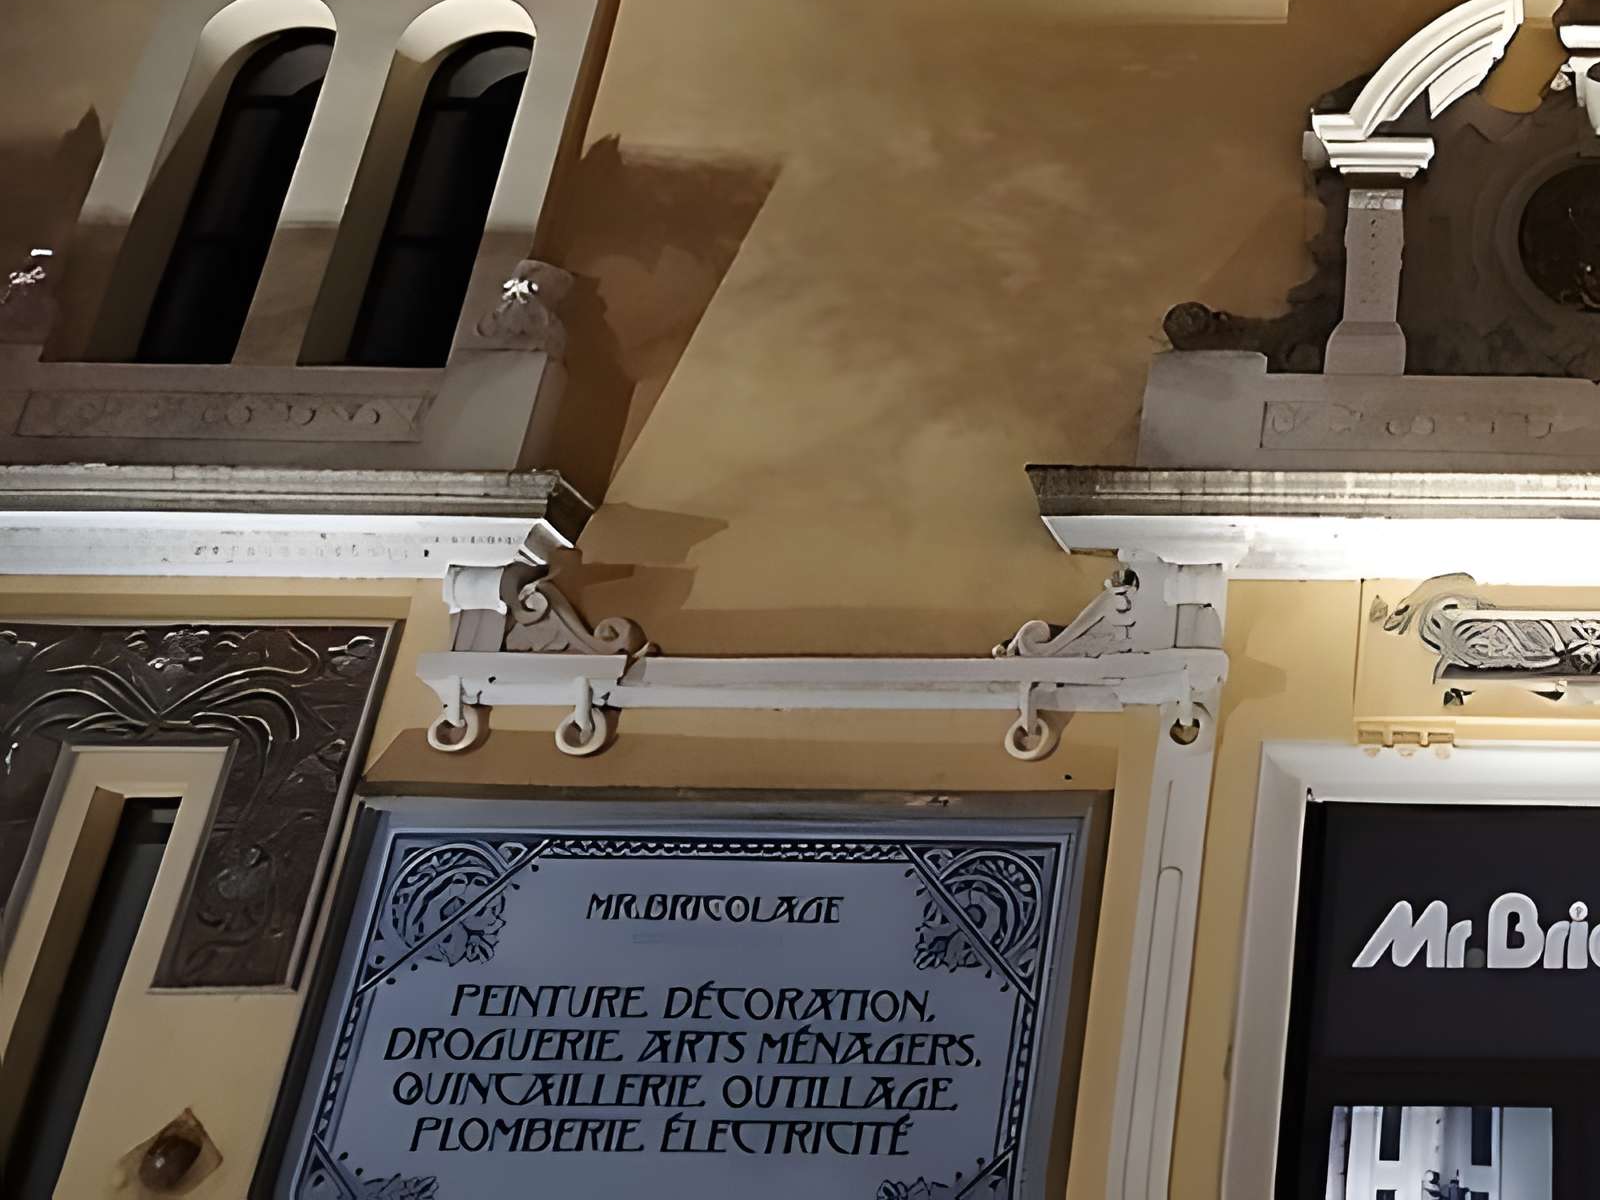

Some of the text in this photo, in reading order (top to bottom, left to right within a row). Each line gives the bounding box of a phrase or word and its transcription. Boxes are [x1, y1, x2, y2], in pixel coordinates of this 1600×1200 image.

[450, 983, 649, 1019] PEINTURE
[637, 1029, 748, 1064] ARTS
[722, 1075, 959, 1112] OUTILLAGE
[409, 1112, 914, 1156] PLOMBERIE ÉLECTRICITÉ
